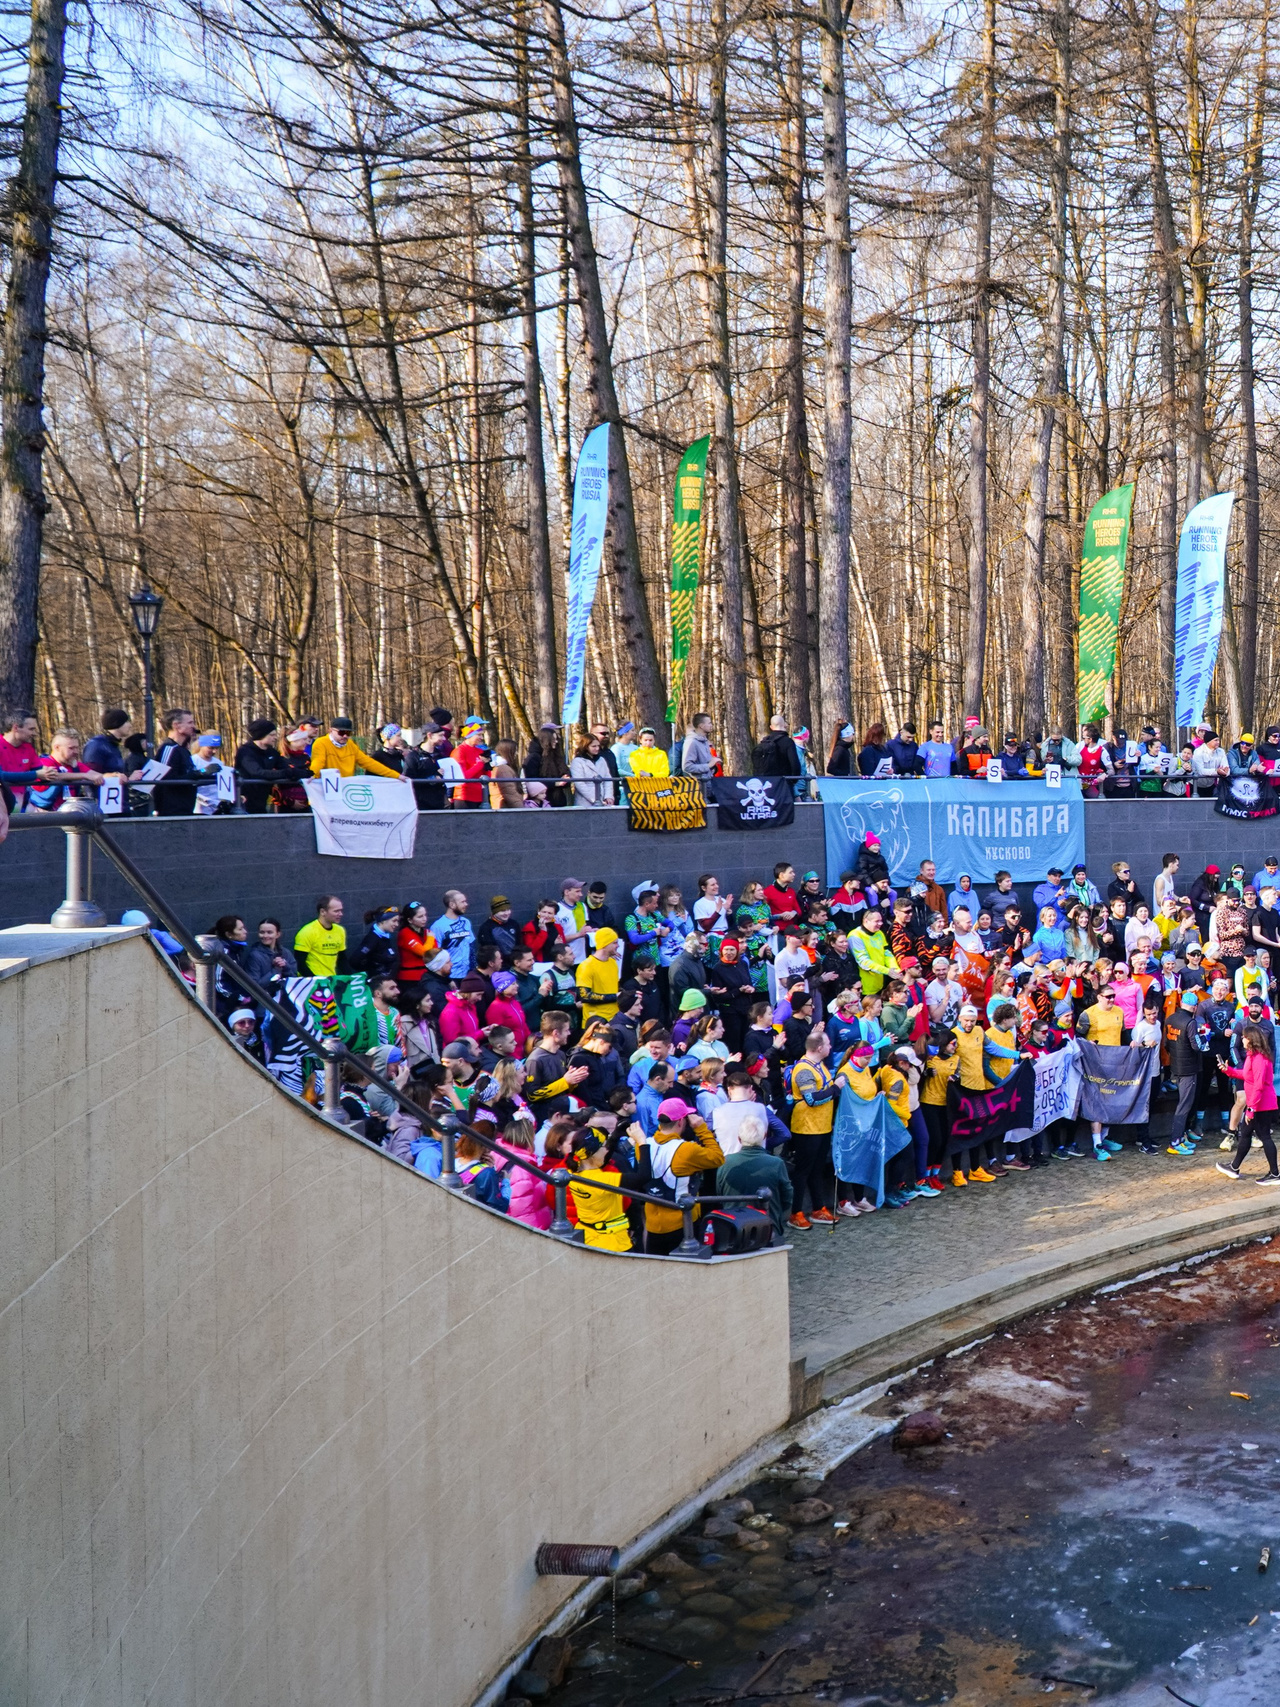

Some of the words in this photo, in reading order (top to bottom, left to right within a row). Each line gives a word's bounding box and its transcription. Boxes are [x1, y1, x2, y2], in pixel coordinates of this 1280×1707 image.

[580, 467, 606, 478] RUNNING
[581, 478, 602, 489] HEROES
[680, 476, 702, 488] RUNNING
[581, 490, 601, 501] RUSSIA
[682, 488, 700, 499] HEROES
[683, 499, 700, 510] RUSSIA
[1092, 518, 1125, 530] RUNNING
[1095, 528, 1121, 538] HEROES
[1188, 526, 1222, 534] RUNNING
[1095, 537, 1120, 547] RUSSIA
[1191, 535, 1217, 543] HEROES
[1191, 543, 1218, 552] RUSSIA
[1160, 757, 1171, 767] S
[880, 763, 890, 773] E
[989, 765, 1000, 777] S
[1049, 770, 1059, 782] R
[219, 775, 231, 792] N
[325, 777, 339, 793] N
[106, 787, 119, 805] R
[656, 789, 672, 798] RHR
[646, 792, 688, 811] HEROES
[747, 805, 771, 813] RHR
[664, 807, 706, 830] RUSSIA
[740, 811, 778, 820] ULTRAS
[947, 804, 1070, 838] КАПИБАРА
[330, 817, 394, 828] #переводчикибегут
[985, 846, 1031, 860] КУСКОВО
[350, 974, 368, 1008] RUN
